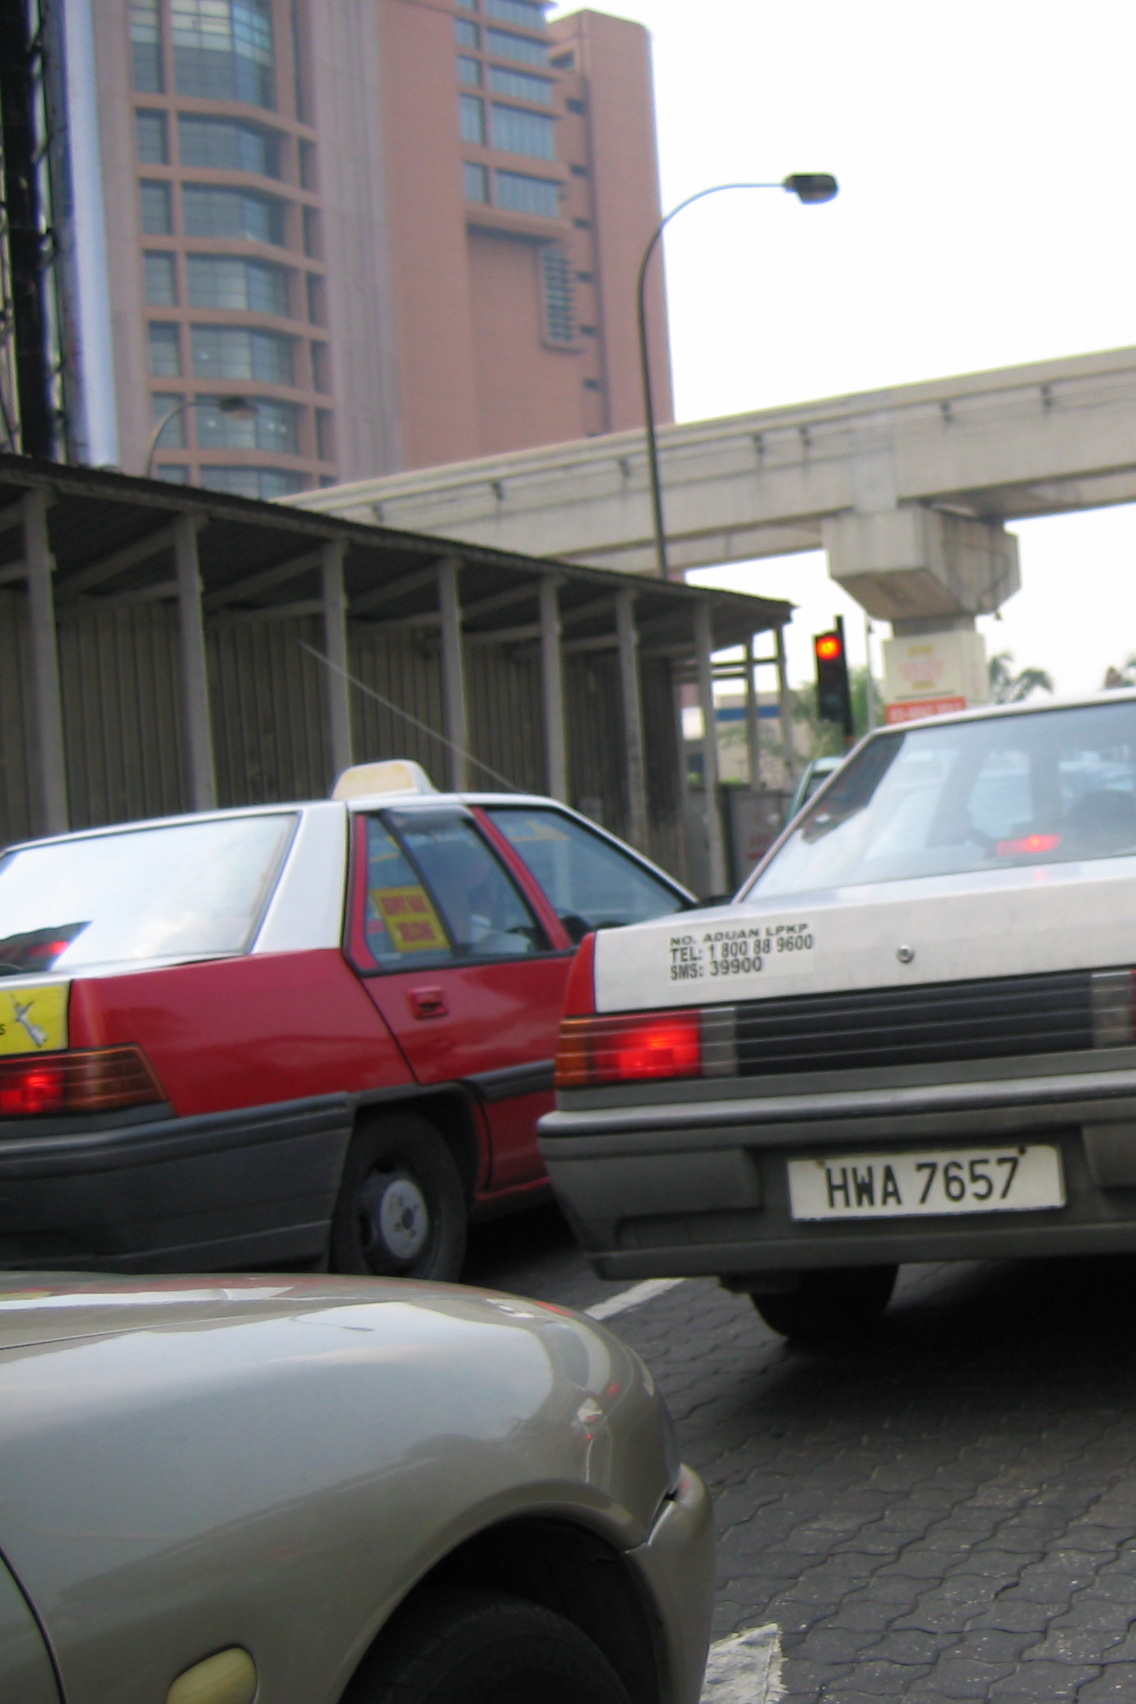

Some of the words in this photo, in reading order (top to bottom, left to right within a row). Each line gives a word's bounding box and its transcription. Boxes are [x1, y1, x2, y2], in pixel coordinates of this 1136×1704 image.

[704, 929, 760, 942] ADUAN
[766, 923, 808, 937] LPKP
[670, 947, 703, 963] TEL:
[721, 941, 748, 958] 800
[753, 938, 771, 955] 88
[777, 934, 814, 952] 9600
[670, 962, 703, 981] SMS:
[709, 956, 763, 976] 39900
[826, 1165, 903, 1208] HWA
[915, 1156, 1019, 1204] 7657
